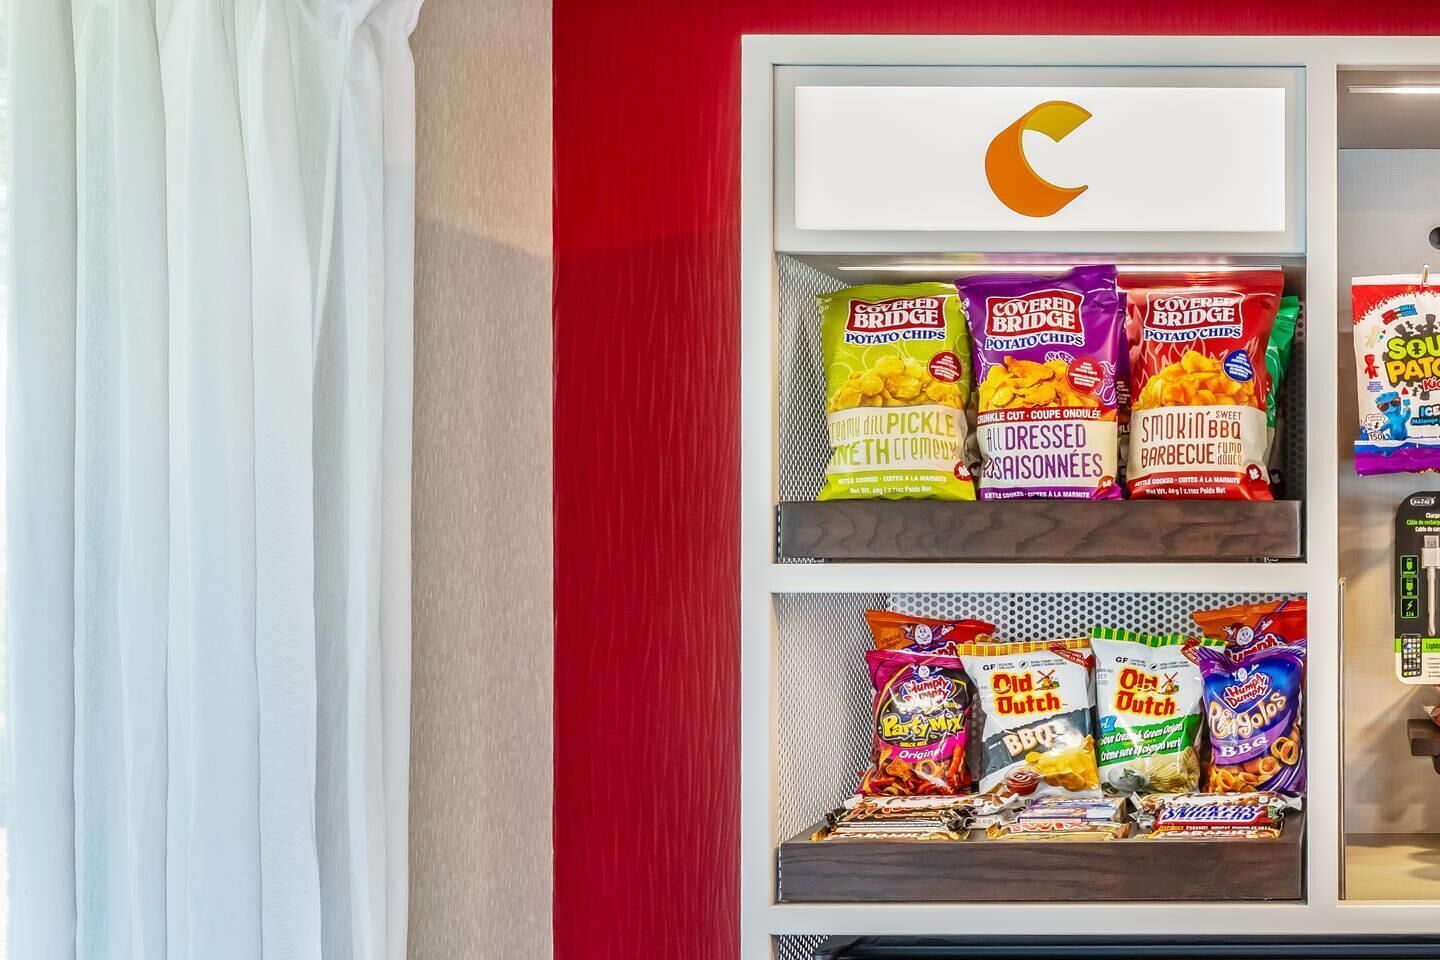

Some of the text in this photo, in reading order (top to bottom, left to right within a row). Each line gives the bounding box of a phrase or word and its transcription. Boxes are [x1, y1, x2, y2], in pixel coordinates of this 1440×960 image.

[854, 298, 939, 313] COVERED
[992, 297, 1075, 316] COVERED
[853, 309, 939, 328] BRIDGE
[992, 312, 1076, 333] BRIDGE
[1152, 306, 1235, 327] BRIDGE
[846, 329, 946, 344] POTATO CHIPS
[986, 333, 1083, 349] POTATO CHIPS
[1145, 327, 1241, 341] POTATO CHIPS
[1007, 410, 1025, 420] CUT
[1031, 409, 1060, 419] COUPE
[1215, 410, 1241, 420] SWEET
[1420, 405, 1440, 417] ICE
[887, 411, 956, 438] PICKLE
[1208, 419, 1241, 440] BBQ
[1005, 423, 1086, 450] DRESSED
[1141, 443, 1215, 468] BARBECUE
[982, 663, 996, 671] GF
[1115, 656, 1129, 664] GF
[993, 673, 1032, 694] Old
[1120, 668, 1159, 692] Old
[1226, 673, 1267, 698] Humpty
[996, 691, 1061, 715] Dutch
[1117, 691, 1176, 716] Dutch
[1226, 684, 1268, 709] Dumpty
[1208, 691, 1288, 739] Ringolos
[883, 713, 964, 741] Party Mix
[1003, 724, 1054, 757] BBQ
[1220, 736, 1269, 758] BBQ
